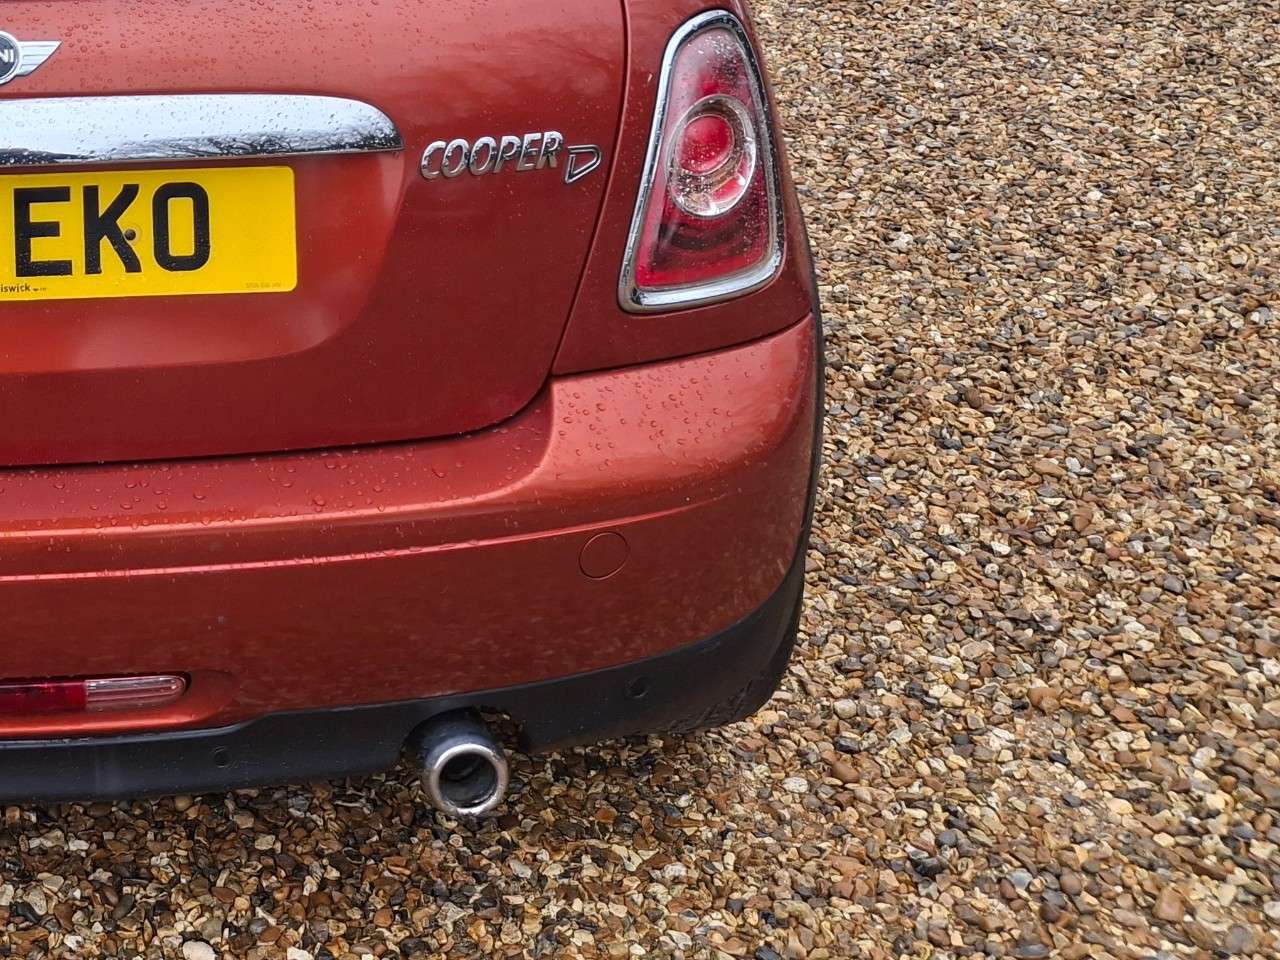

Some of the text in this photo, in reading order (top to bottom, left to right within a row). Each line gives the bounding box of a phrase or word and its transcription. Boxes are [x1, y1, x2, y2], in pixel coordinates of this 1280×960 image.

[420, 131, 604, 184] COOPER D
[13, 182, 211, 277] EKO
